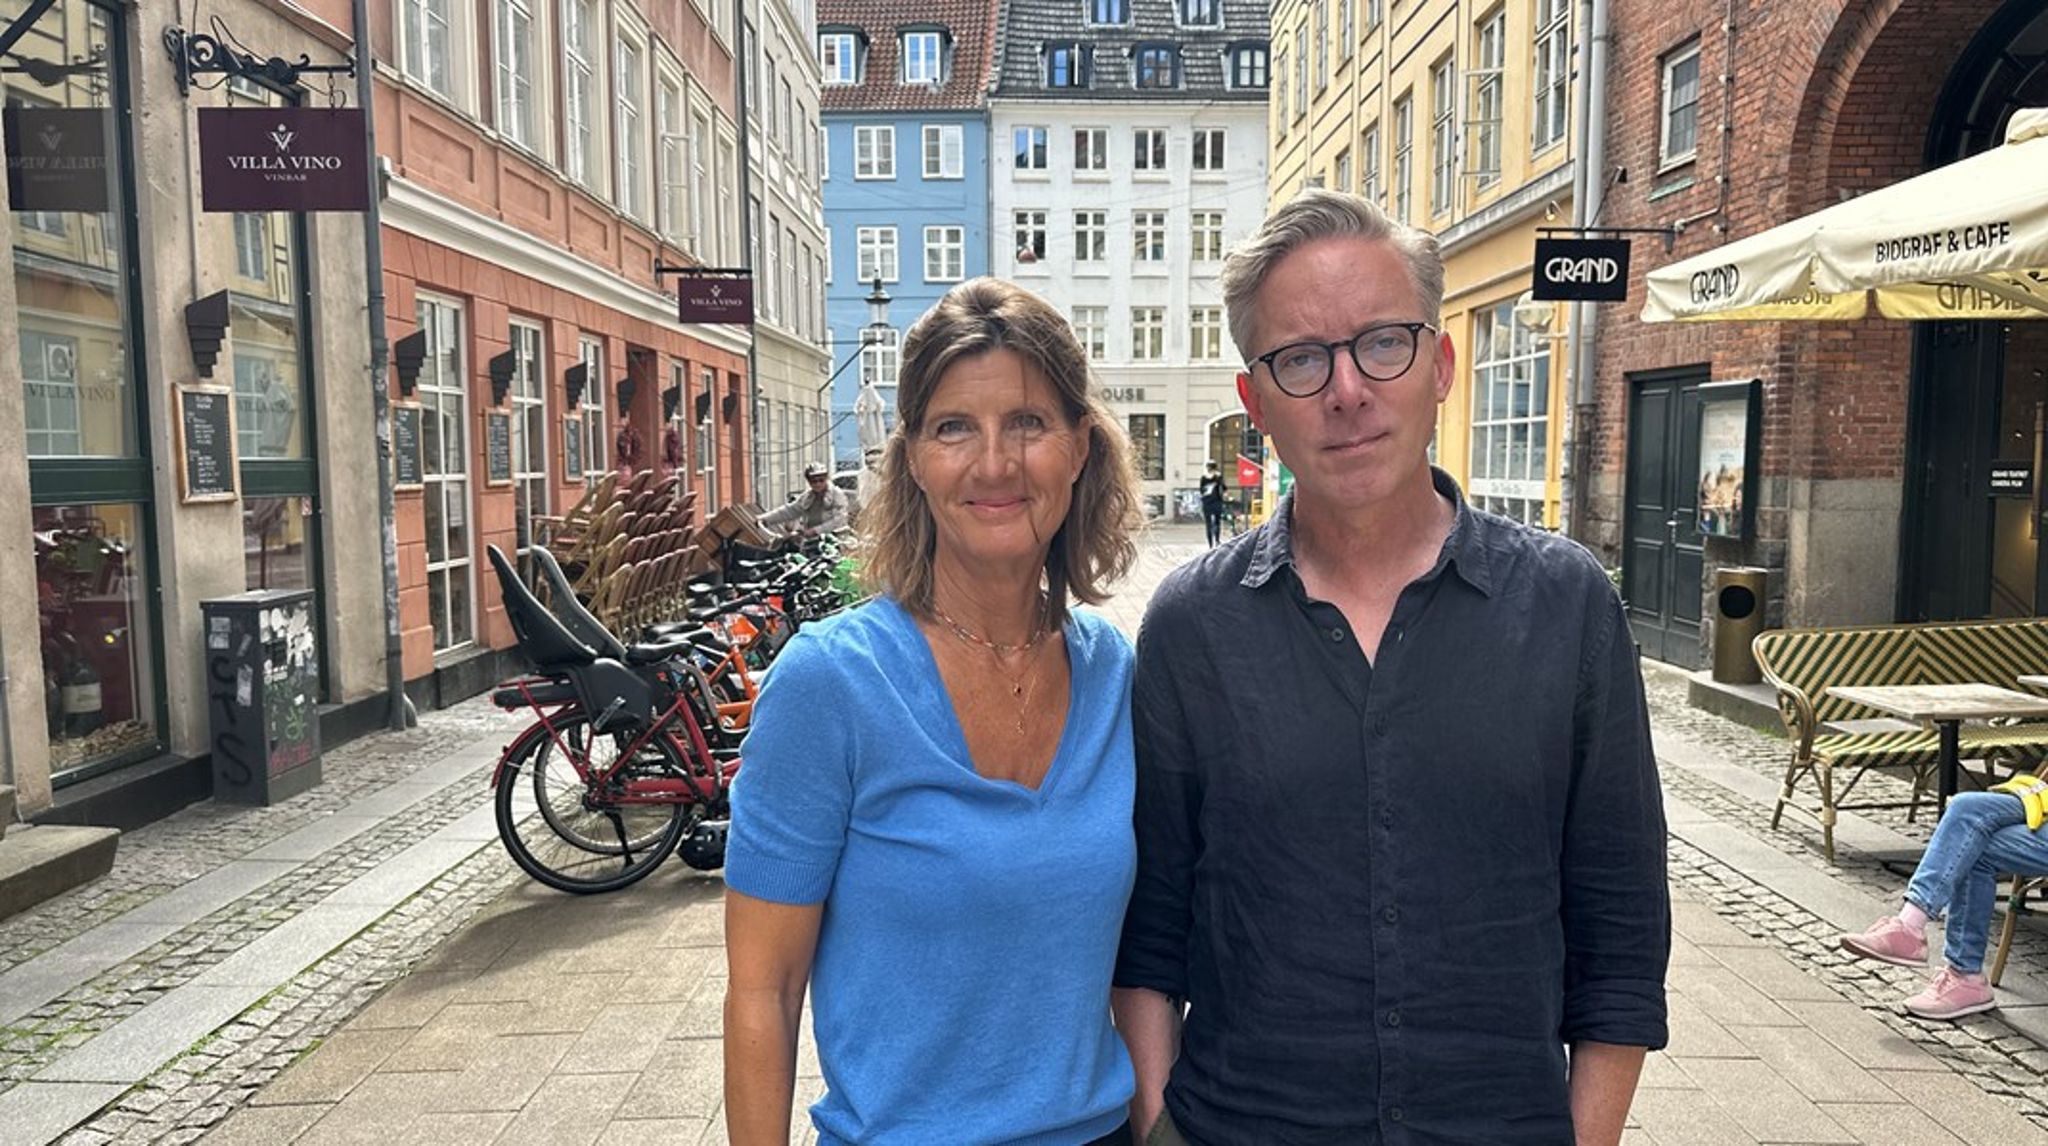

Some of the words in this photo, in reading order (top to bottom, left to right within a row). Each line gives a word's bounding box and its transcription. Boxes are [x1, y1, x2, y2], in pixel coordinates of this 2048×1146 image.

[227, 156, 286, 169] VILLA
[290, 156, 341, 169] VINO
[264, 173, 307, 181] VINBAR
[1876, 232, 1942, 263] BIOGRAF
[1948, 229, 1959, 253] &
[1964, 221, 2010, 250] CAFE
[1544, 257, 1619, 283] GRAND
[1690, 263, 1740, 304] GRAND
[690, 298, 719, 306] VILLA
[720, 298, 743, 306] VINO
[1101, 387, 1145, 402] OUSE
